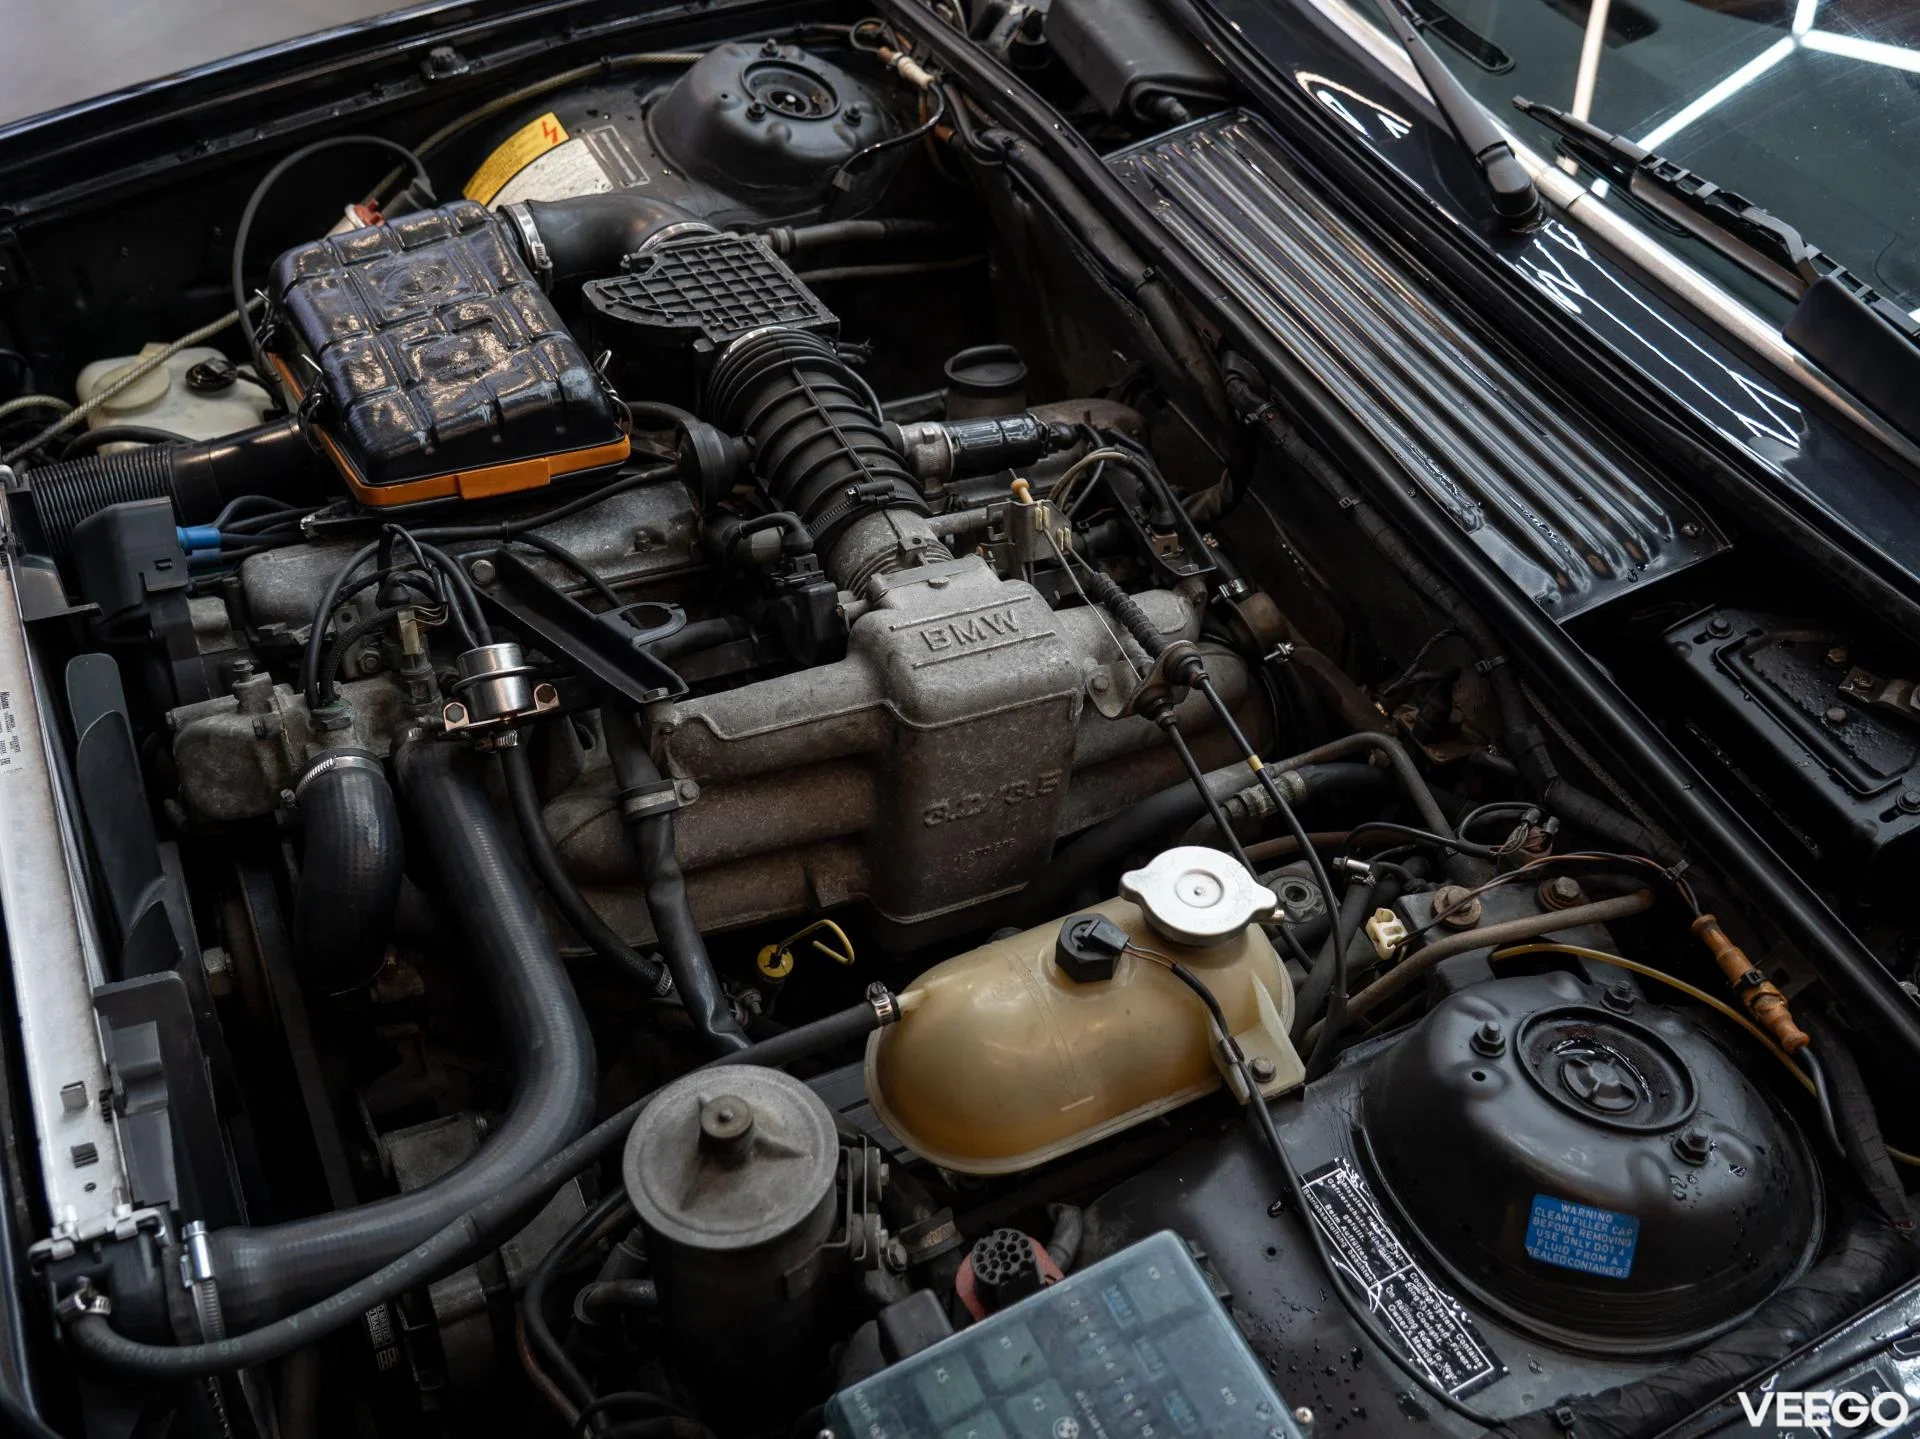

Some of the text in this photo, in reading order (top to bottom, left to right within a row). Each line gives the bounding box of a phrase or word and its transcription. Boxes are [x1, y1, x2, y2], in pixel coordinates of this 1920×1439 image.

[920, 609, 1022, 651] BMW
[1325, 1203, 1341, 1224] Beim
[1534, 1206, 1633, 1236] CLEAN FILLER CAP
[1561, 1203, 1613, 1223] WARNING
[1532, 1216, 1632, 1247] BEFORE REMOVING
[1536, 1228, 1625, 1257] USE ONLY DOT 4
[1527, 1247, 1567, 1265] SEALED
[1567, 1257, 1625, 1277] CONTAINER
[1536, 1239, 1619, 1266] FLUID FROM A
[311, 1291, 361, 1319] FUEL
[1385, 1286, 1396, 1299] On
[1418, 1329, 1436, 1351] Refer
[1432, 1303, 1456, 1332] System
[1456, 1333, 1483, 1368] Contains
[1141, 1423, 1154, 1437] 10
